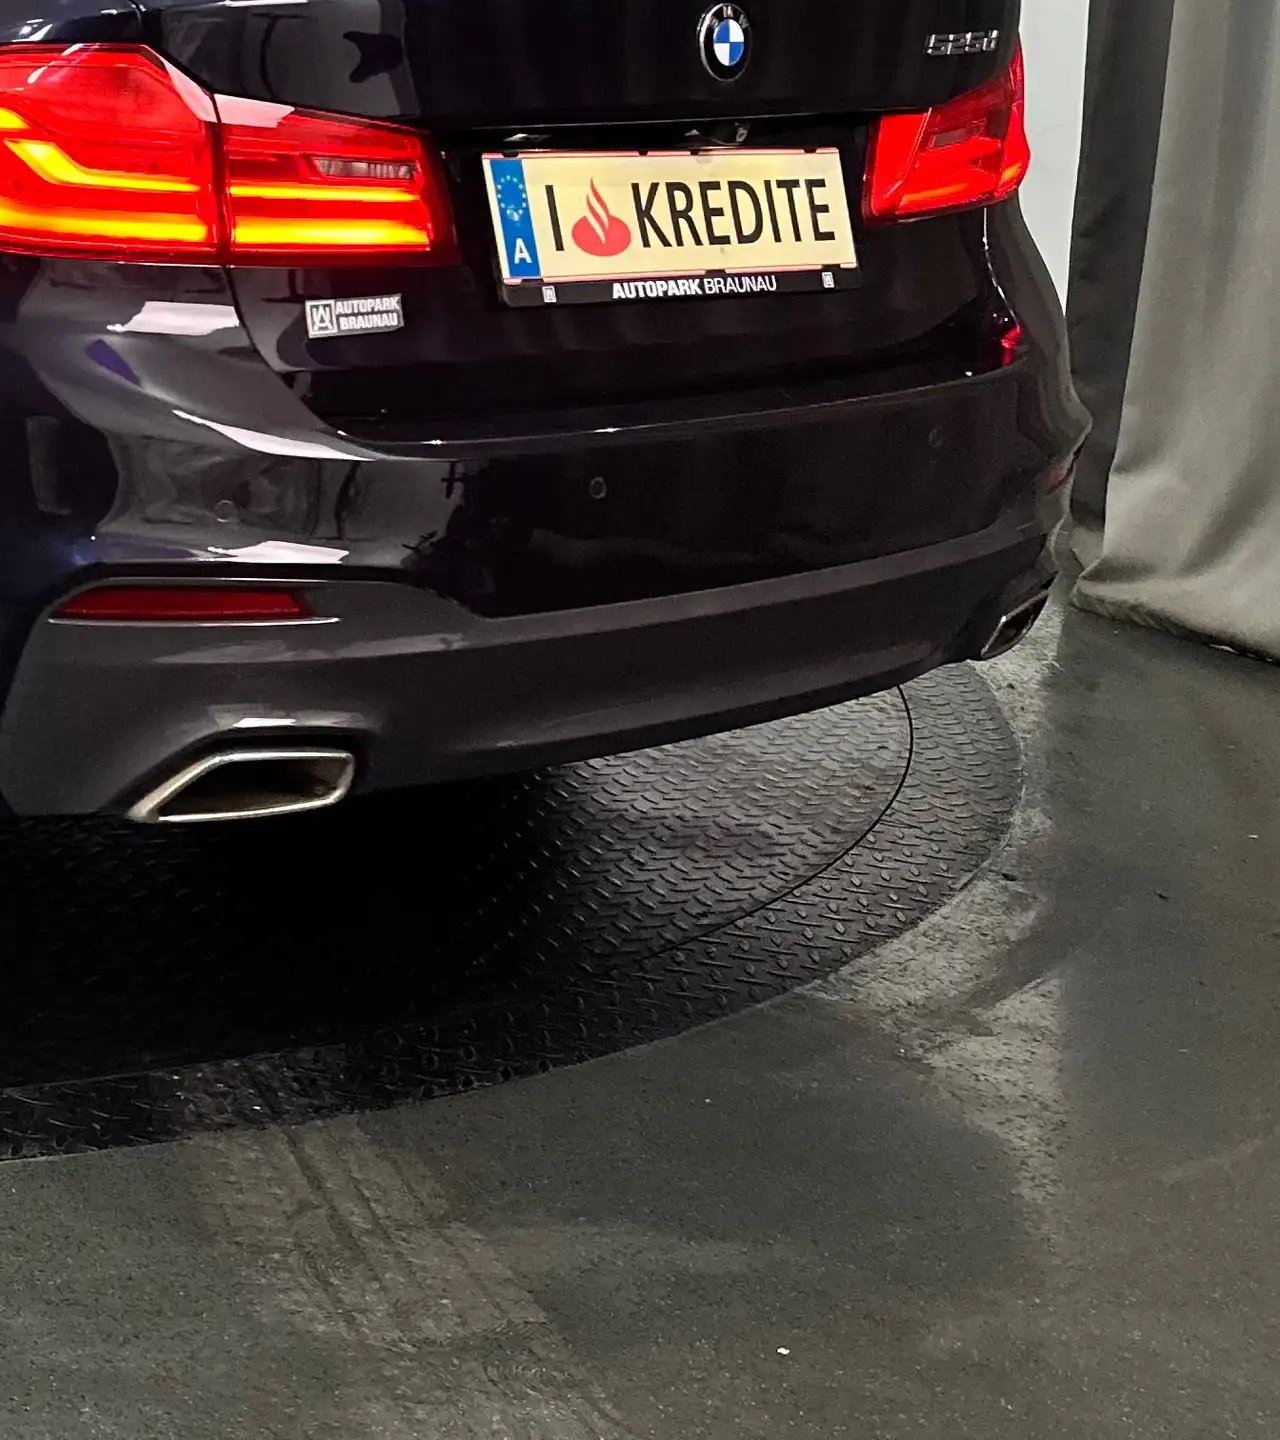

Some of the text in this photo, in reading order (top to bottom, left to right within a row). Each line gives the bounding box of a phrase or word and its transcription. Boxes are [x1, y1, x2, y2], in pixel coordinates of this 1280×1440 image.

[545, 177, 836, 252] I KREDITE
[513, 239, 534, 264] A
[611, 274, 778, 300] AUTOPARK BRAUNAU
[335, 296, 400, 315] AUTOPARK
[338, 312, 399, 331] BRAUNAU
